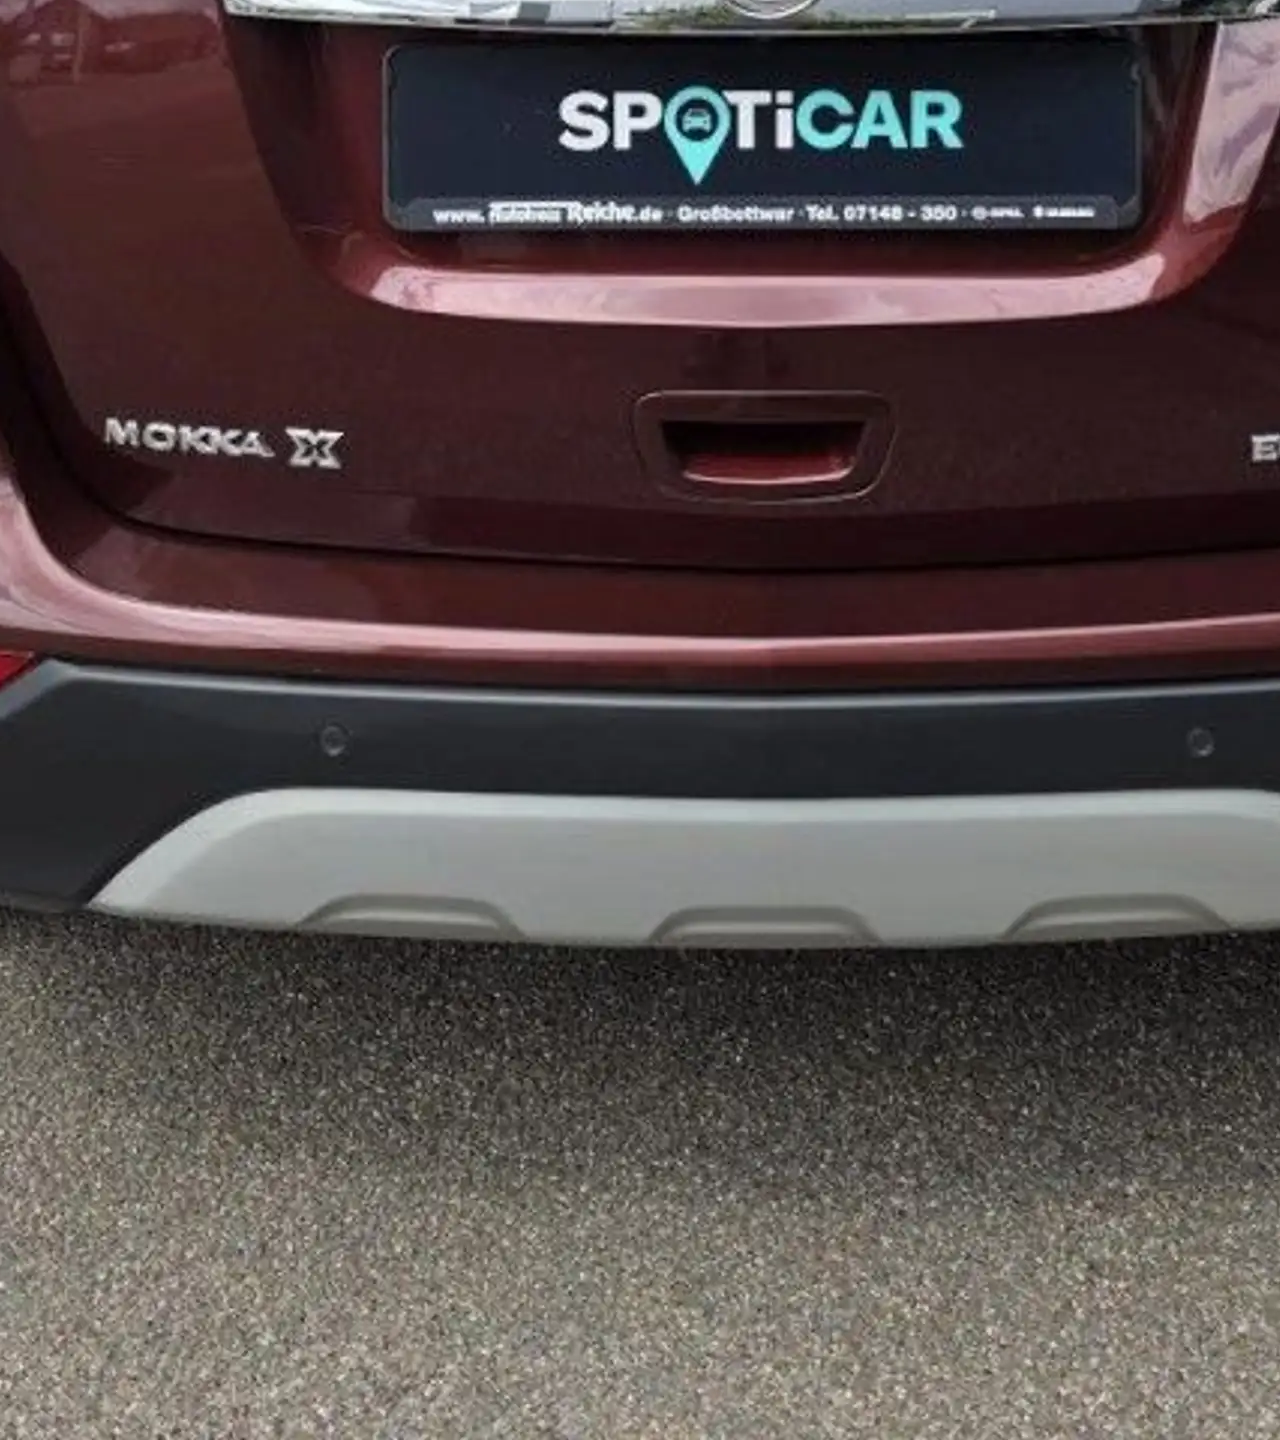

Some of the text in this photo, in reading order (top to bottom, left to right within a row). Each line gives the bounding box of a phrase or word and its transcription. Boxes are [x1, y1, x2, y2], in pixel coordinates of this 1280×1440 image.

[432, 209, 485, 224] www.
[805, 203, 839, 222] Tel.
[104, 417, 345, 470] MOKKA X
